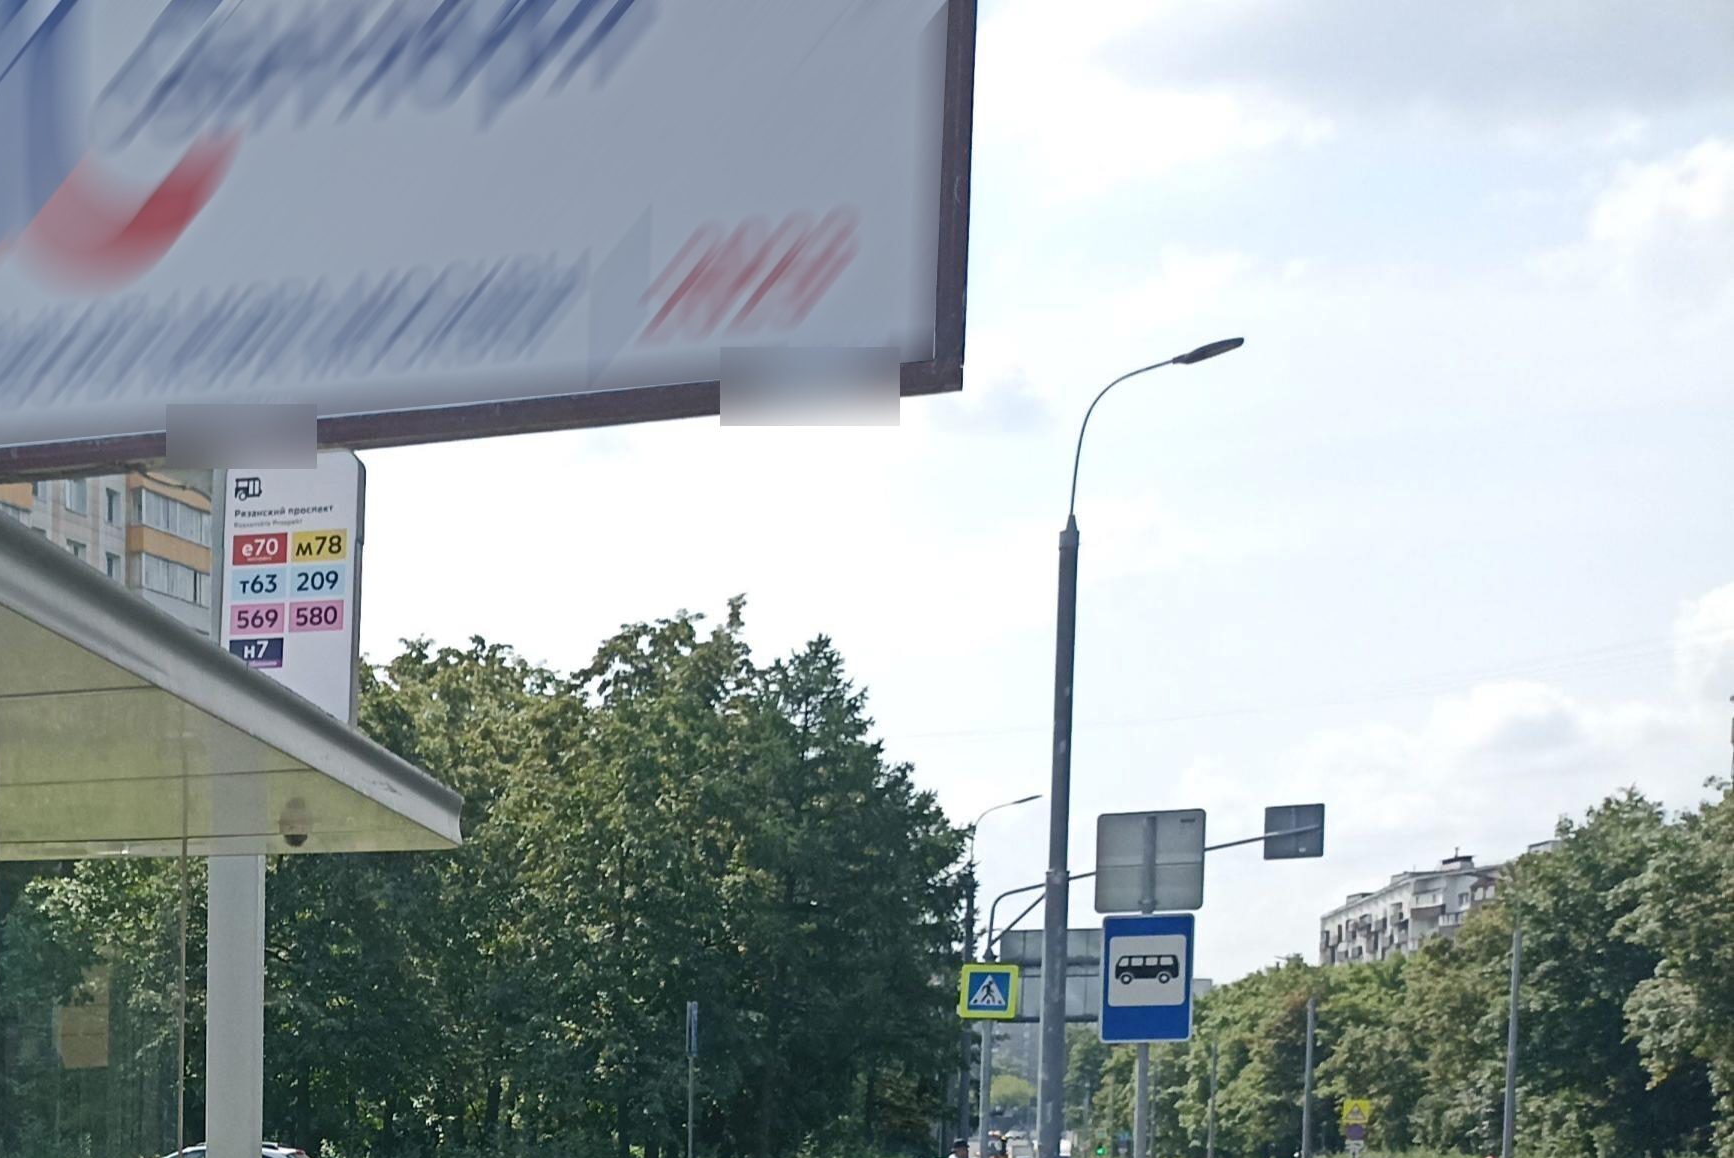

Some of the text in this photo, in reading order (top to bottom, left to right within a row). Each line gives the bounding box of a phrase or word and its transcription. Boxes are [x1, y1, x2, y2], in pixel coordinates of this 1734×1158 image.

[288, 505, 334, 517] проспект
[297, 570, 339, 592] 209
[237, 609, 278, 629] 569
[296, 606, 338, 627] 580
